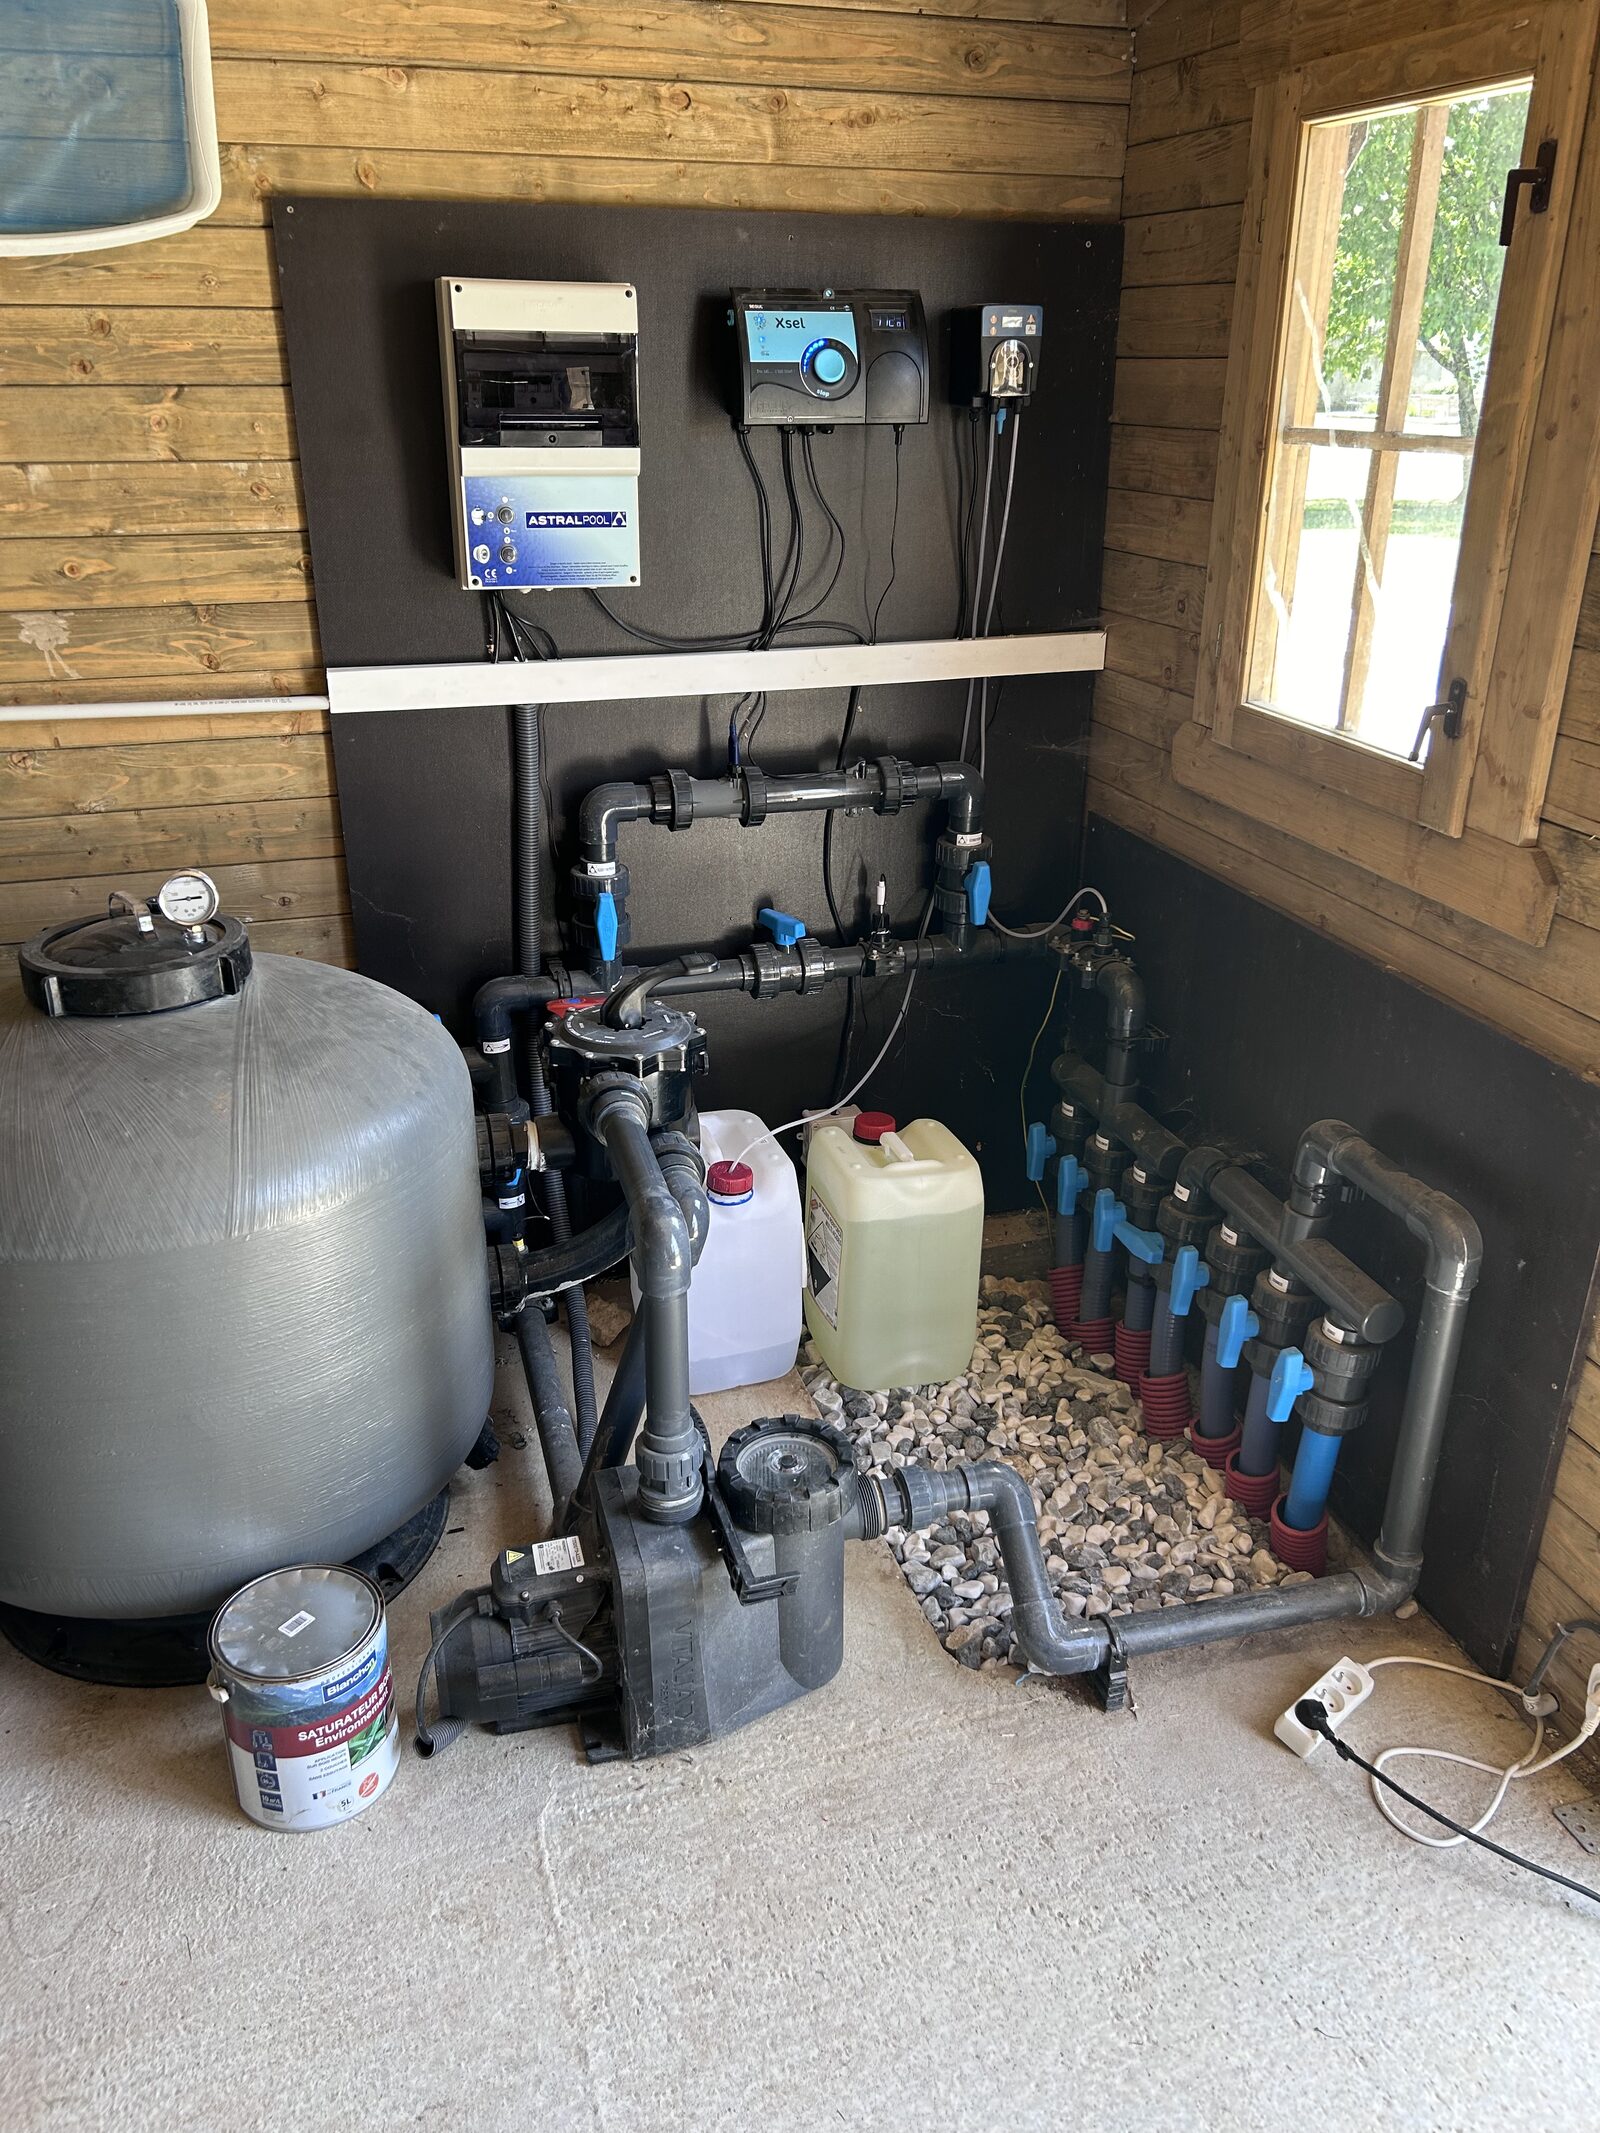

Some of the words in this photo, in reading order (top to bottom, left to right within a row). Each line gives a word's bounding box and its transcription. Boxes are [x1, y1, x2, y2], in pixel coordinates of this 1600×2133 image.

[775, 317, 806, 329] Xsel
[528, 515, 610, 526] ASTRALPOOL
[484, 568, 497, 578] CE
[327, 1657, 376, 1697] Blanchon
[298, 1691, 378, 1741] SATURATEUR
[315, 1686, 389, 1748] Environnement
